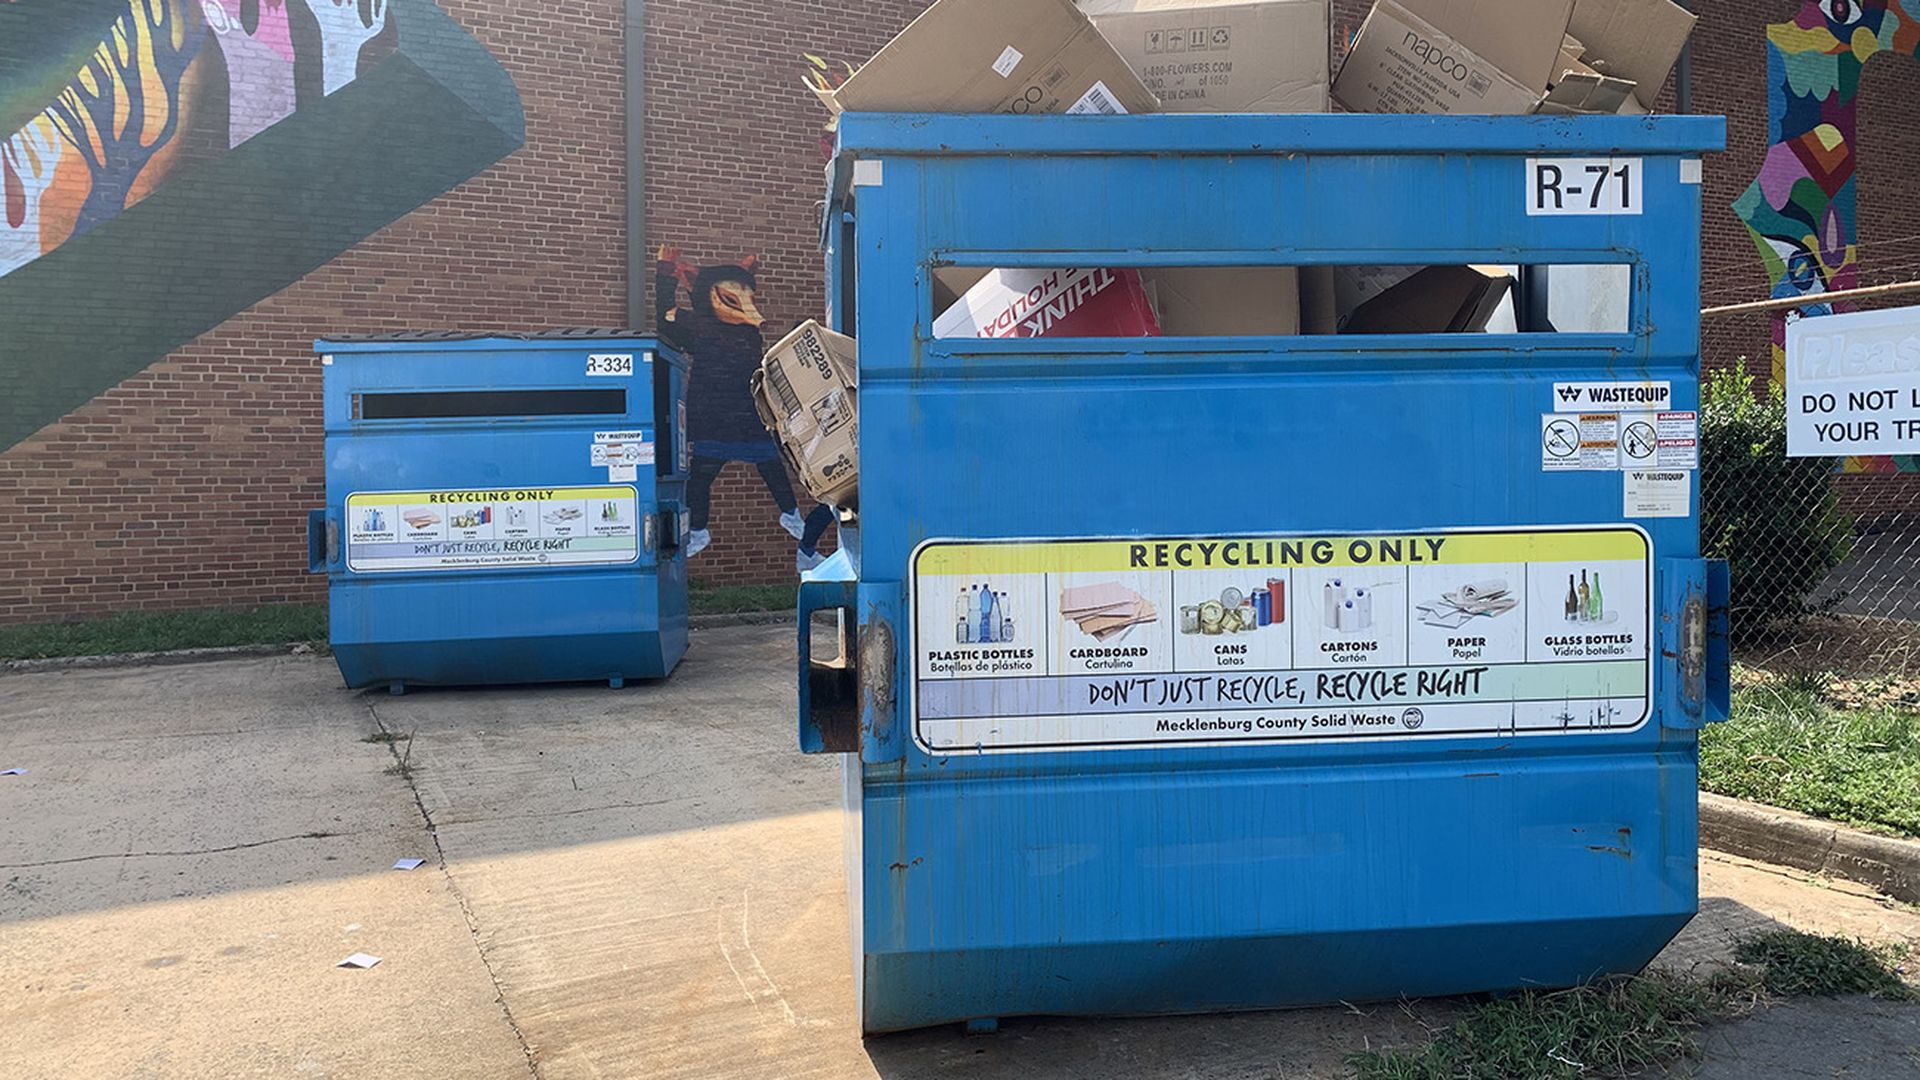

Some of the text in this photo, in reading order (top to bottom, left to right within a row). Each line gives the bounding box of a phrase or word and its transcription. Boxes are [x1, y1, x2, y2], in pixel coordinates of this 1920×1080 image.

[1402, 31, 1468, 82] napco
[1143, 62, 1233, 77] 1-800-FLOWERS.COM
[1178, 89, 1206, 100] CHINA
[1449, 88, 1461, 99] USA
[1536, 164, 1632, 209] R-71
[977, 272, 1058, 337] HOLIDA
[1024, 267, 1116, 337] THINK
[803, 329, 832, 380] 982289
[587, 357, 631, 372] R-334
[1588, 387, 1669, 403] WASTEQUIP
[1802, 394, 1836, 413] DO
[1849, 390, 1899, 411] NOT
[1814, 420, 1920, 442] YOUR TR
[1646, 472, 1685, 481] WASTEQUIP
[430, 491, 554, 503] RECYCLING ONLY
[415, 538, 572, 555] DON'T JUST RECYCLE, RECYCLE RIGHT
[1130, 538, 1446, 567] RECYCLING ONLY
[1447, 637, 1486, 647] PAPER
[1544, 634, 1633, 646] GLASS BOTTLES
[1069, 647, 1149, 658] CARDBOARD
[1214, 644, 1248, 655] CANS
[1320, 641, 1379, 652] CARTONS
[1552, 645, 1626, 656] Vidrio botellas
[928, 649, 1034, 661] PLASTIC BOTTLES
[1331, 652, 1367, 663] Cartón
[1452, 648, 1482, 660] Papel
[930, 660, 1033, 673] Botellas de plástico
[1085, 657, 1134, 669] Cartulina
[1216, 656, 1245, 666] Latas
[1089, 667, 1489, 705] DON'T JUST RECYCLE, RECYCLE RIGHT
[1156, 712, 1396, 732] Mecklenburg County Solid Waste
